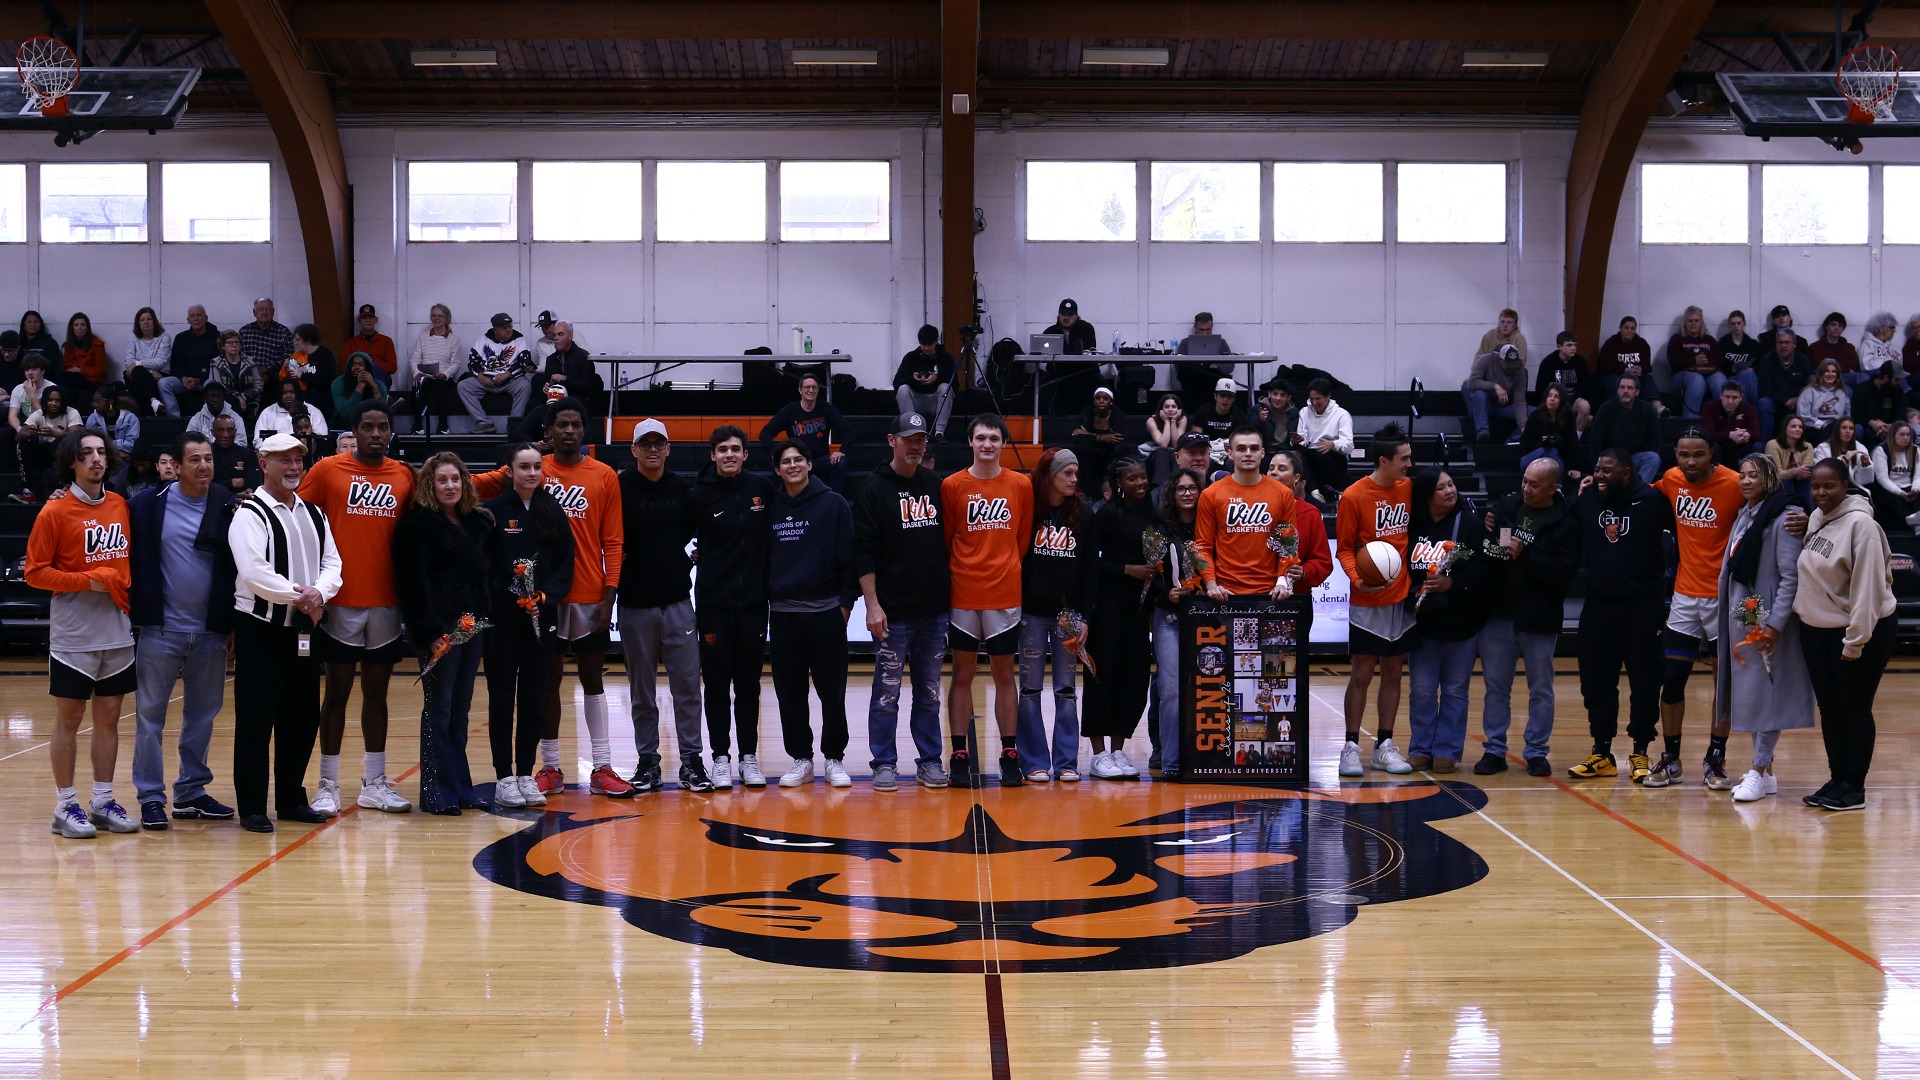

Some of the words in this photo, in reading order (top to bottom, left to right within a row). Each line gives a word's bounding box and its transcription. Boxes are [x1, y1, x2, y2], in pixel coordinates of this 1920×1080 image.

[347, 481, 398, 510] Ville
[1679, 488, 1690, 496] THE
[347, 507, 397, 518] BASKETBALL
[564, 510, 587, 518] TBALL
[900, 495, 937, 522] Ville
[967, 498, 1012, 525] Ville
[1226, 502, 1273, 527] Ville
[1676, 495, 1717, 522] Ville
[82, 519, 98, 527] THE
[1375, 503, 1410, 531] Ville
[772, 521, 794, 530] VISIONS
[794, 520, 804, 528] OF
[902, 519, 939, 529] BASKETBALL
[967, 523, 1011, 532] BASKETBALL
[1679, 518, 1719, 529] ASKETBALL
[85, 522, 128, 555] Ville
[777, 528, 805, 537] PARADOX
[1034, 525, 1077, 551] Ville
[85, 550, 130, 564] BASKETBALL
[1034, 547, 1077, 558] BASKETBALL
[1411, 540, 1447, 563] Vill
[1320, 593, 1348, 603] dental
[1188, 605, 1219, 617] Joseph
[1221, 681, 1232, 694] 26
